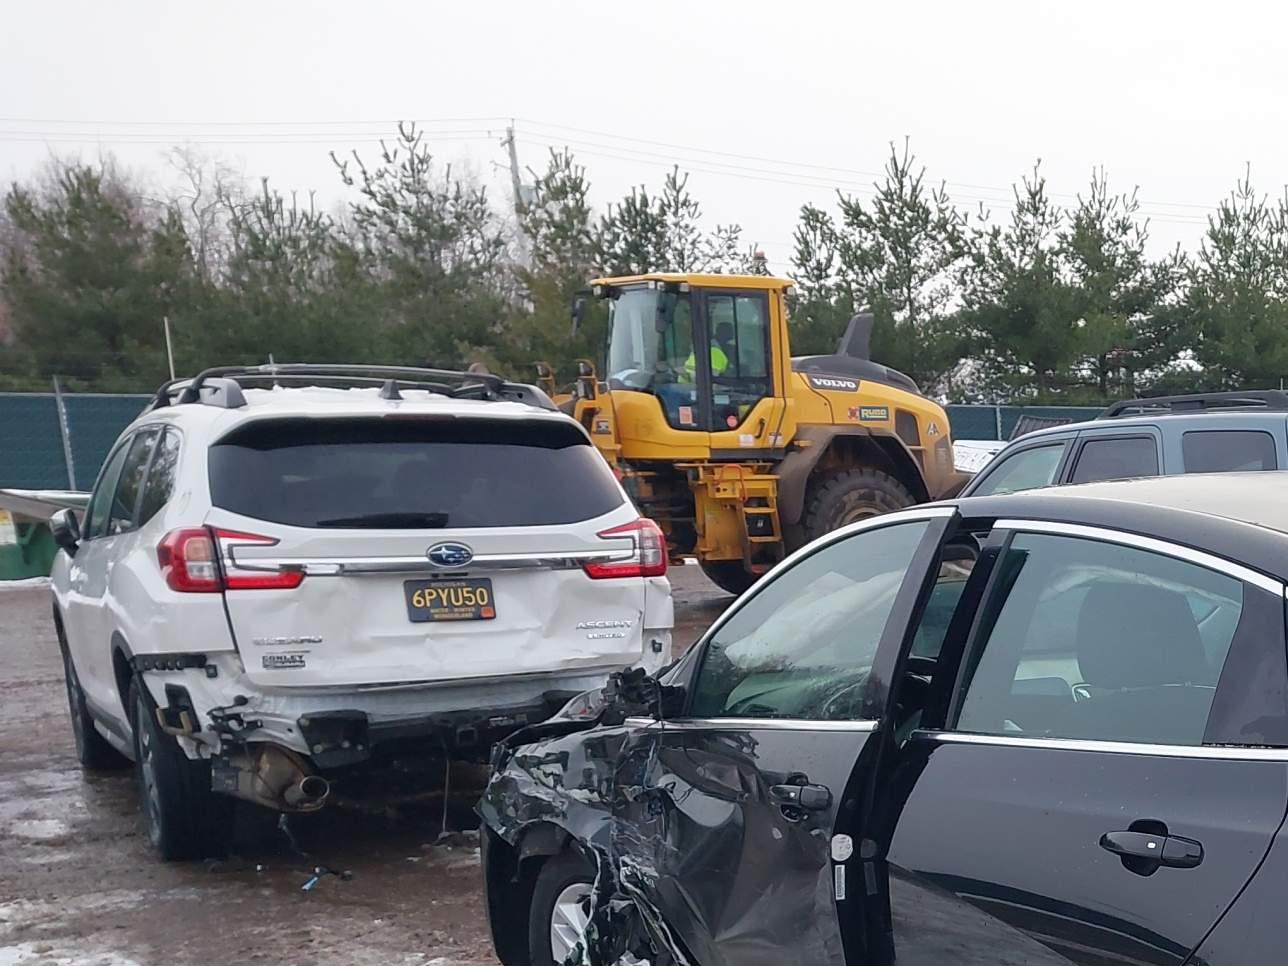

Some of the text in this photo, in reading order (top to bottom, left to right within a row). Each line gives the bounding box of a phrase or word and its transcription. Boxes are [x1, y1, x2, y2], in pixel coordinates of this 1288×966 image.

[812, 378, 856, 389] VOLVO
[412, 587, 489, 608] 6PYU50
[576, 620, 632, 630] ASCENT
